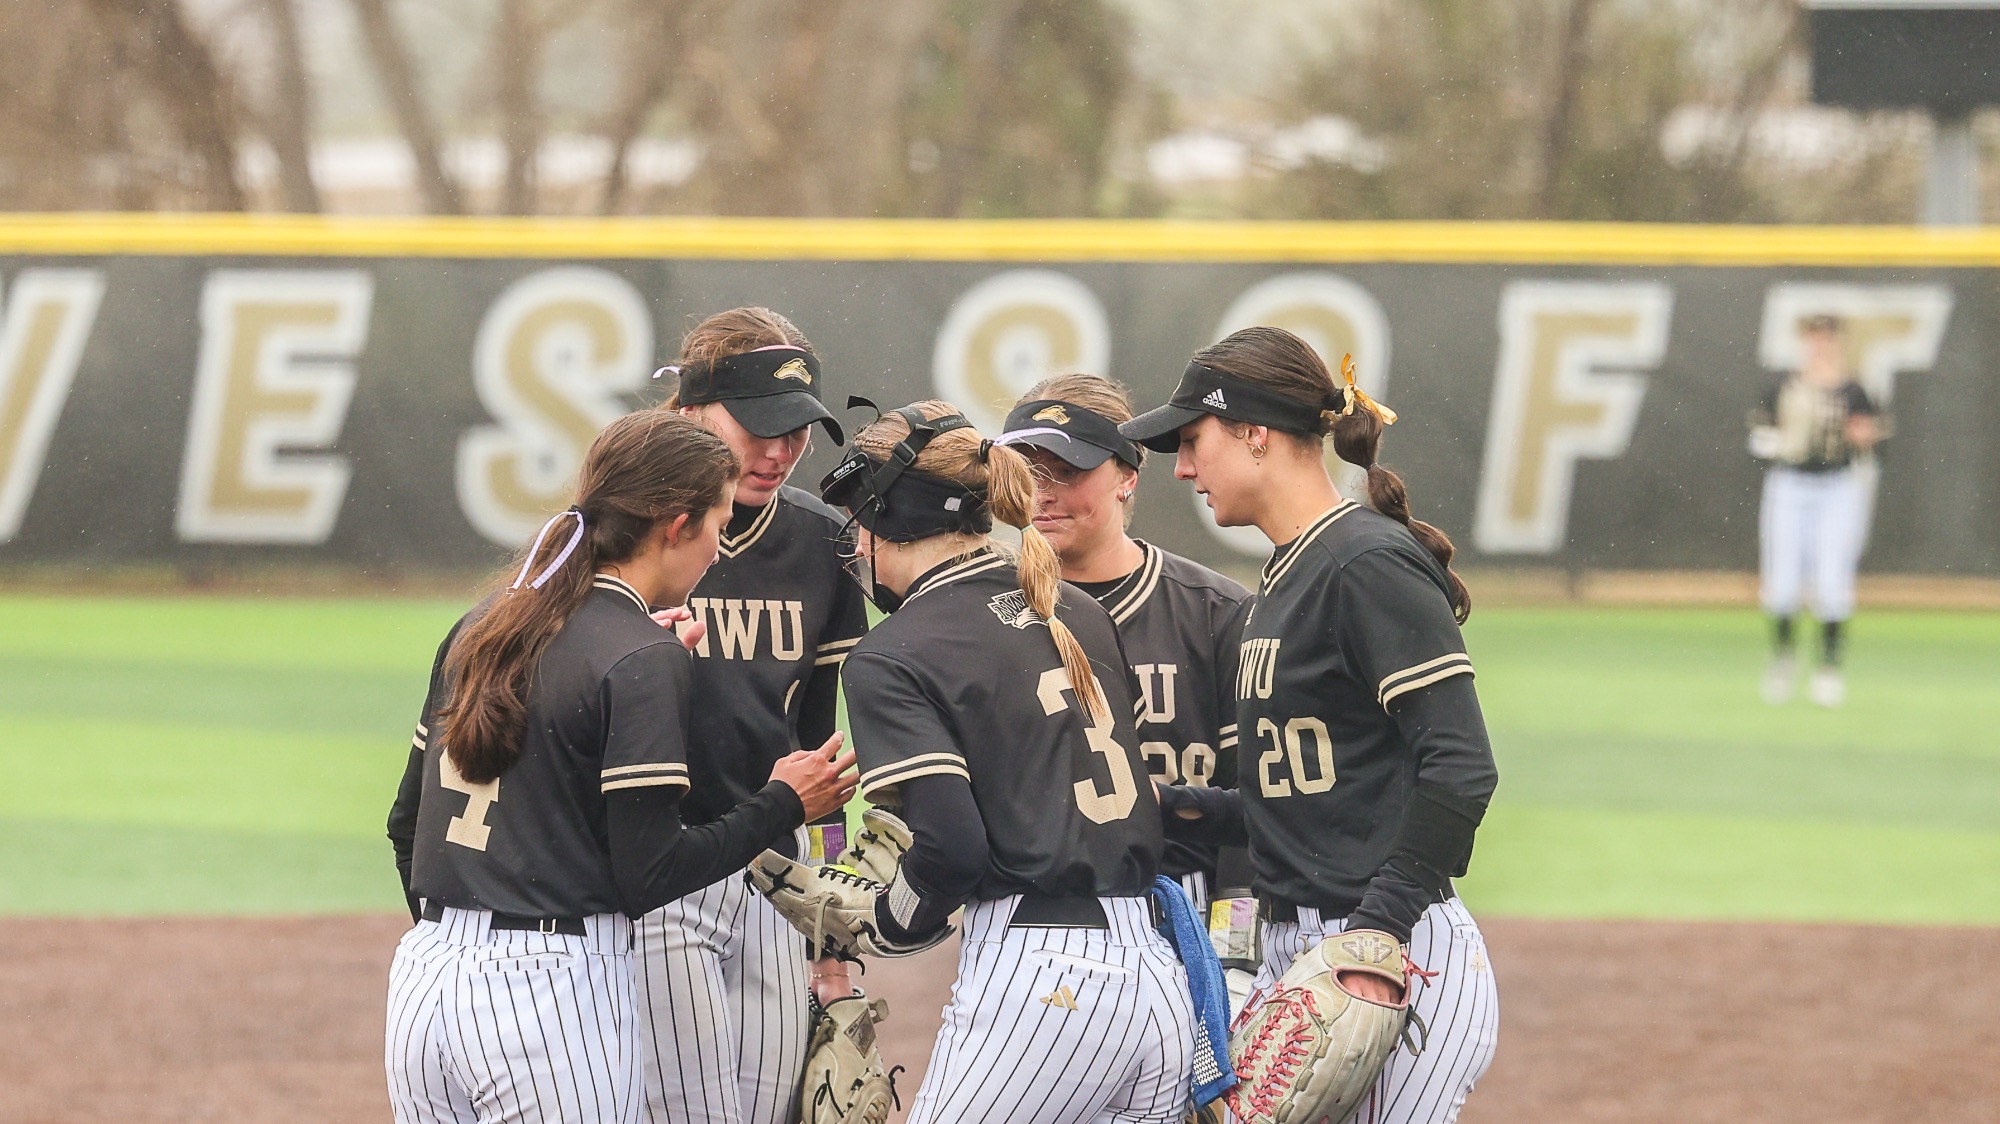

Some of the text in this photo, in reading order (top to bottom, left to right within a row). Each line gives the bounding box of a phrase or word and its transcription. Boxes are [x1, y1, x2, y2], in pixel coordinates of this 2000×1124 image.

[1202, 397, 1228, 410] adidas
[1235, 638, 1281, 701] WU
[1036, 666, 1138, 825] 3
[1256, 716, 1337, 798] 20
